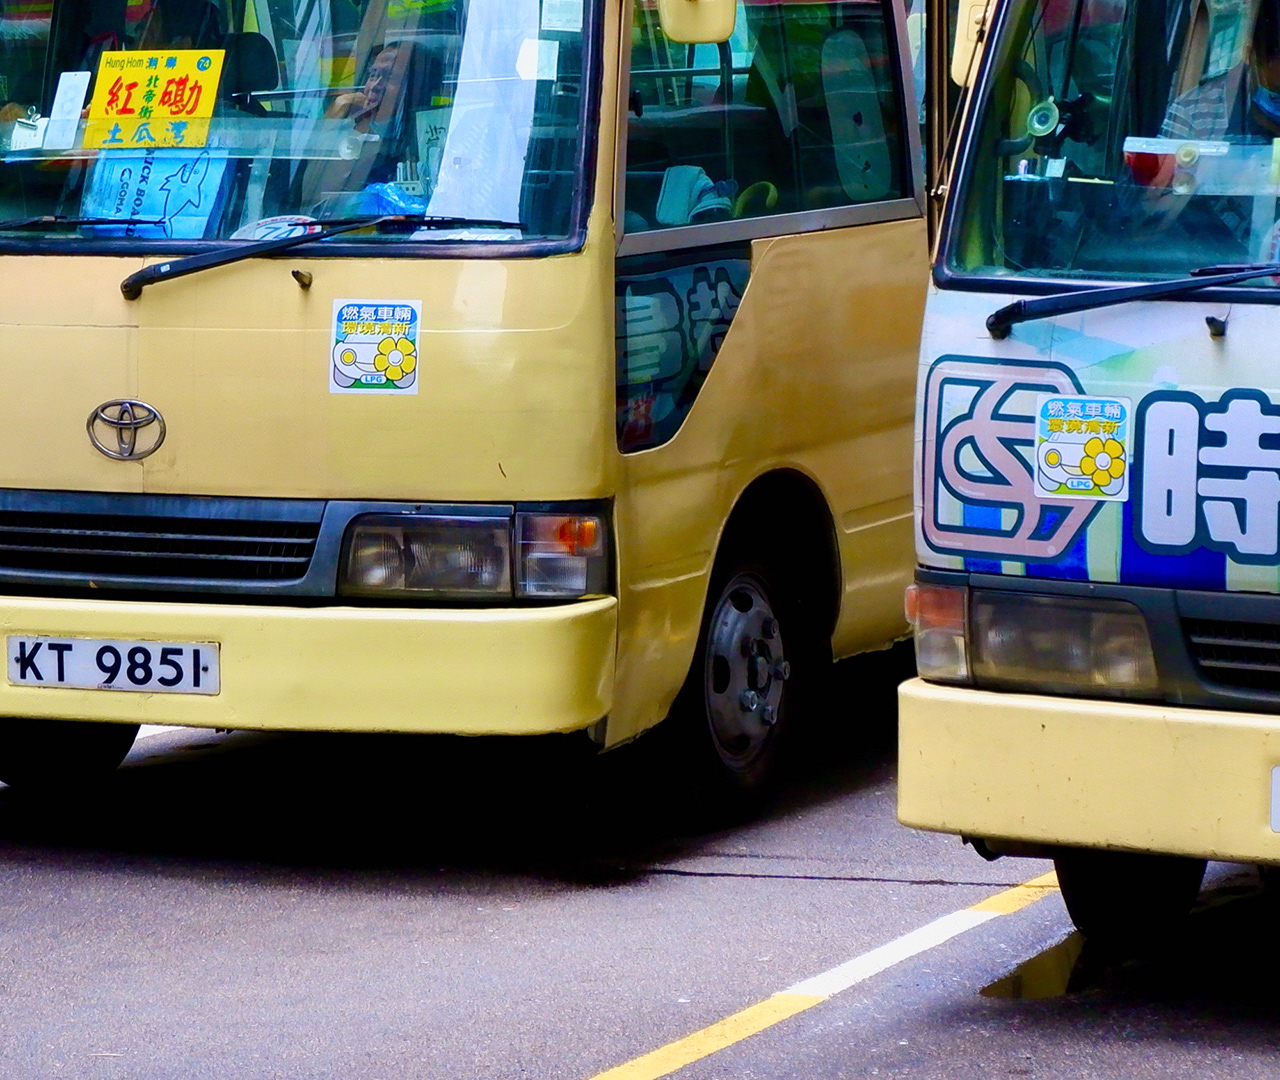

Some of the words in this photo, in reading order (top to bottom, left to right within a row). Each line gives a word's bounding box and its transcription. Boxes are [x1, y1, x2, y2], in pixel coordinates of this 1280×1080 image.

[104, 57, 126, 71] Hung
[125, 57, 144, 68] Hom
[104, 73, 203, 116] 紅磡
[138, 75, 160, 120] 北帝街
[102, 120, 189, 145] 土瓜灣
[341, 306, 413, 321] 燃氣車輛
[364, 375, 383, 384] LPG
[1070, 480, 1091, 488] LPG
[19, 641, 73, 683] KT
[94, 645, 203, 689] 9851
